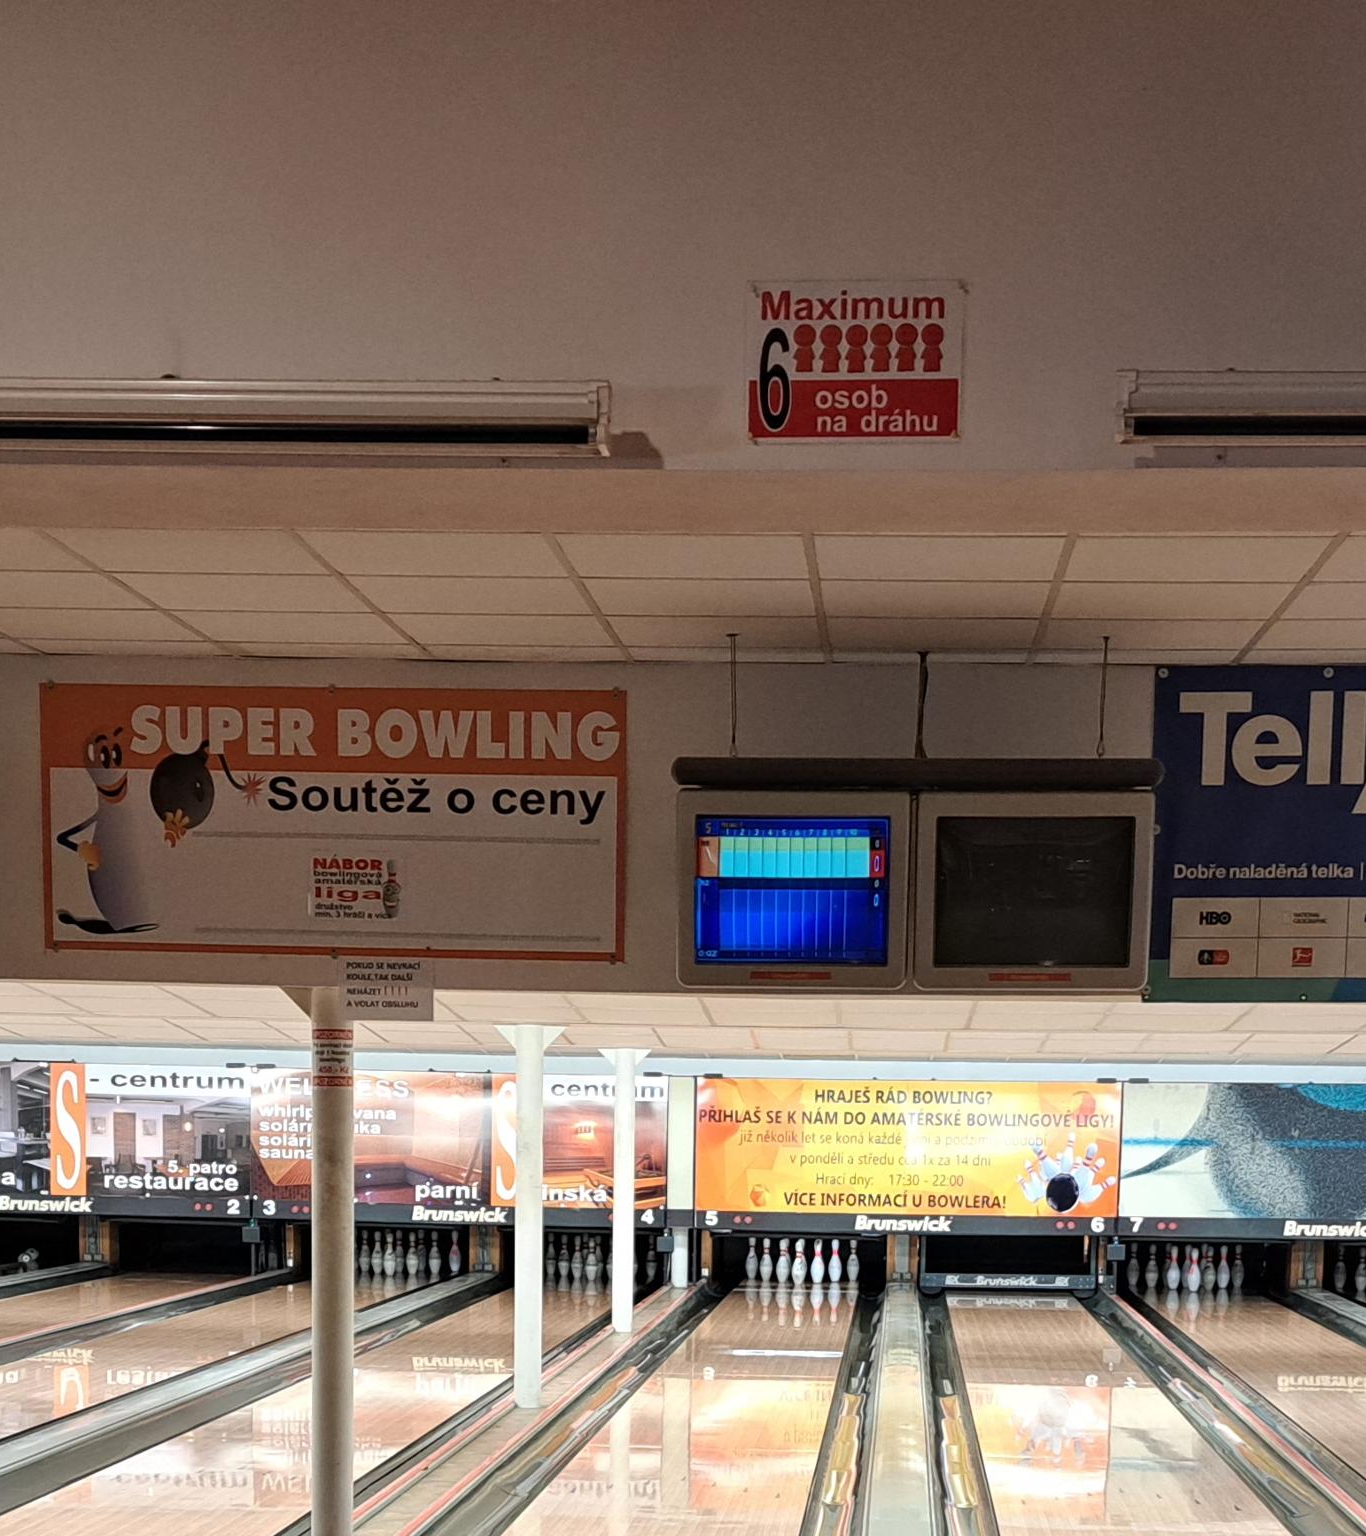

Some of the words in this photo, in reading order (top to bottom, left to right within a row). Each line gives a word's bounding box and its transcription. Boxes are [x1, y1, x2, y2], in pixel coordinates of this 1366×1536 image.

[761, 290, 945, 320] Maximum
[759, 328, 791, 430] 6
[815, 384, 888, 410] osob
[817, 414, 847, 433] na
[861, 409, 938, 433] dráhu
[130, 704, 317, 757] SUPER
[336, 708, 620, 761] BOWLING
[267, 776, 431, 813] Soutěž
[446, 787, 475, 814] o
[492, 788, 606, 825] ceny
[313, 853, 383, 871] NÁBOR
[1173, 863, 1226, 879] Dobře
[1229, 863, 1308, 879] naladěná
[1311, 864, 1354, 879] telka
[313, 870, 382, 879] bowlingová
[315, 877, 382, 885] amatérská
[315, 886, 381, 902] liga
[1199, 911, 1232, 925] HBO
[354, 1000, 379, 1008] VOLAT
[110, 1072, 244, 1089] centrum
[259, 1077, 410, 1099] WELESS
[550, 1082, 664, 1098] centm
[814, 1087, 870, 1103] HRAJEŠ
[876, 1087, 907, 1104] RÁD
[912, 1090, 993, 1105] BOWLING?
[258, 1104, 313, 1121] whirlp
[699, 1105, 761, 1123] PŘIHLAŠ
[766, 1110, 782, 1124] SE
[787, 1111, 796, 1124] K
[802, 1107, 838, 1125] NÁM
[844, 1111, 866, 1125] DO
[870, 1109, 961, 1126] AMATÉRSKÉ
[967, 1110, 1071, 1127] BOWLINGOVÉ
[1076, 1113, 1114, 1128] LIGY!
[756, 1131, 798, 1144] několik
[167, 1160, 184, 1174] 5.
[188, 1161, 238, 1177] patro
[103, 1172, 239, 1192] restaurace
[889, 1174, 920, 1186] 17:30
[932, 1174, 964, 1187] 22:00
[415, 1181, 478, 1202] parní
[542, 1184, 607, 1202] inská
[784, 1189, 817, 1207] VÍCE
[820, 1190, 908, 1208] INFORMACÍ
[912, 1192, 923, 1208] U
[928, 1194, 1006, 1209] BOWLERA!
[226, 1199, 241, 1215] 2
[262, 1200, 276, 1216] 3
[412, 1205, 507, 1224] Brunswick
[640, 1209, 655, 1225] 4
[705, 1211, 719, 1227] 5
[854, 1215, 952, 1232] Brunswick
[1090, 1217, 1105, 1233] 6
[1130, 1218, 1144, 1233] 7
